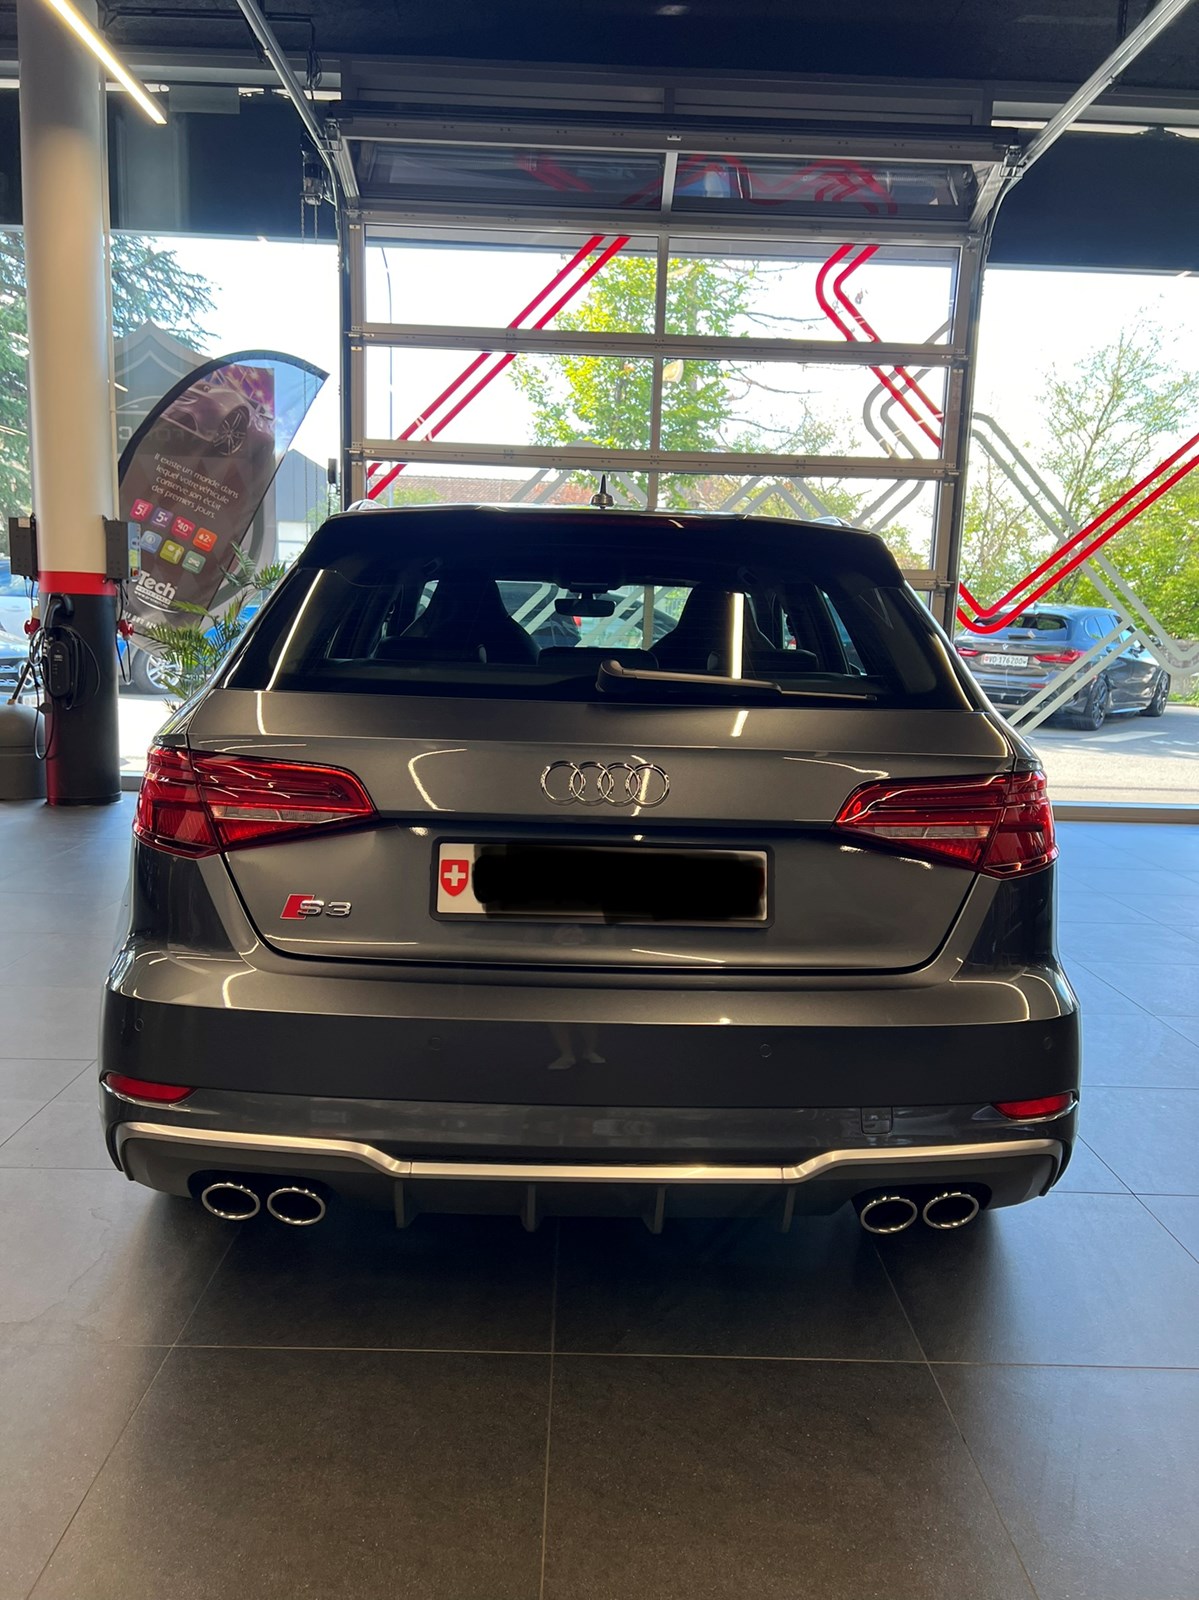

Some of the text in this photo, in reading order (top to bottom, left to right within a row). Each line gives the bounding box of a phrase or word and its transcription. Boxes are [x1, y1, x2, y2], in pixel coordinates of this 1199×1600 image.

[155, 463, 230, 504] lequel votre véhicule
[155, 474, 221, 510] conserve son éclat
[159, 455, 182, 470] existe
[181, 466, 193, 475] un
[193, 471, 220, 488] monde
[219, 484, 239, 498] dans
[150, 483, 217, 520] des premiers jours.
[298, 900, 352, 916] S3
